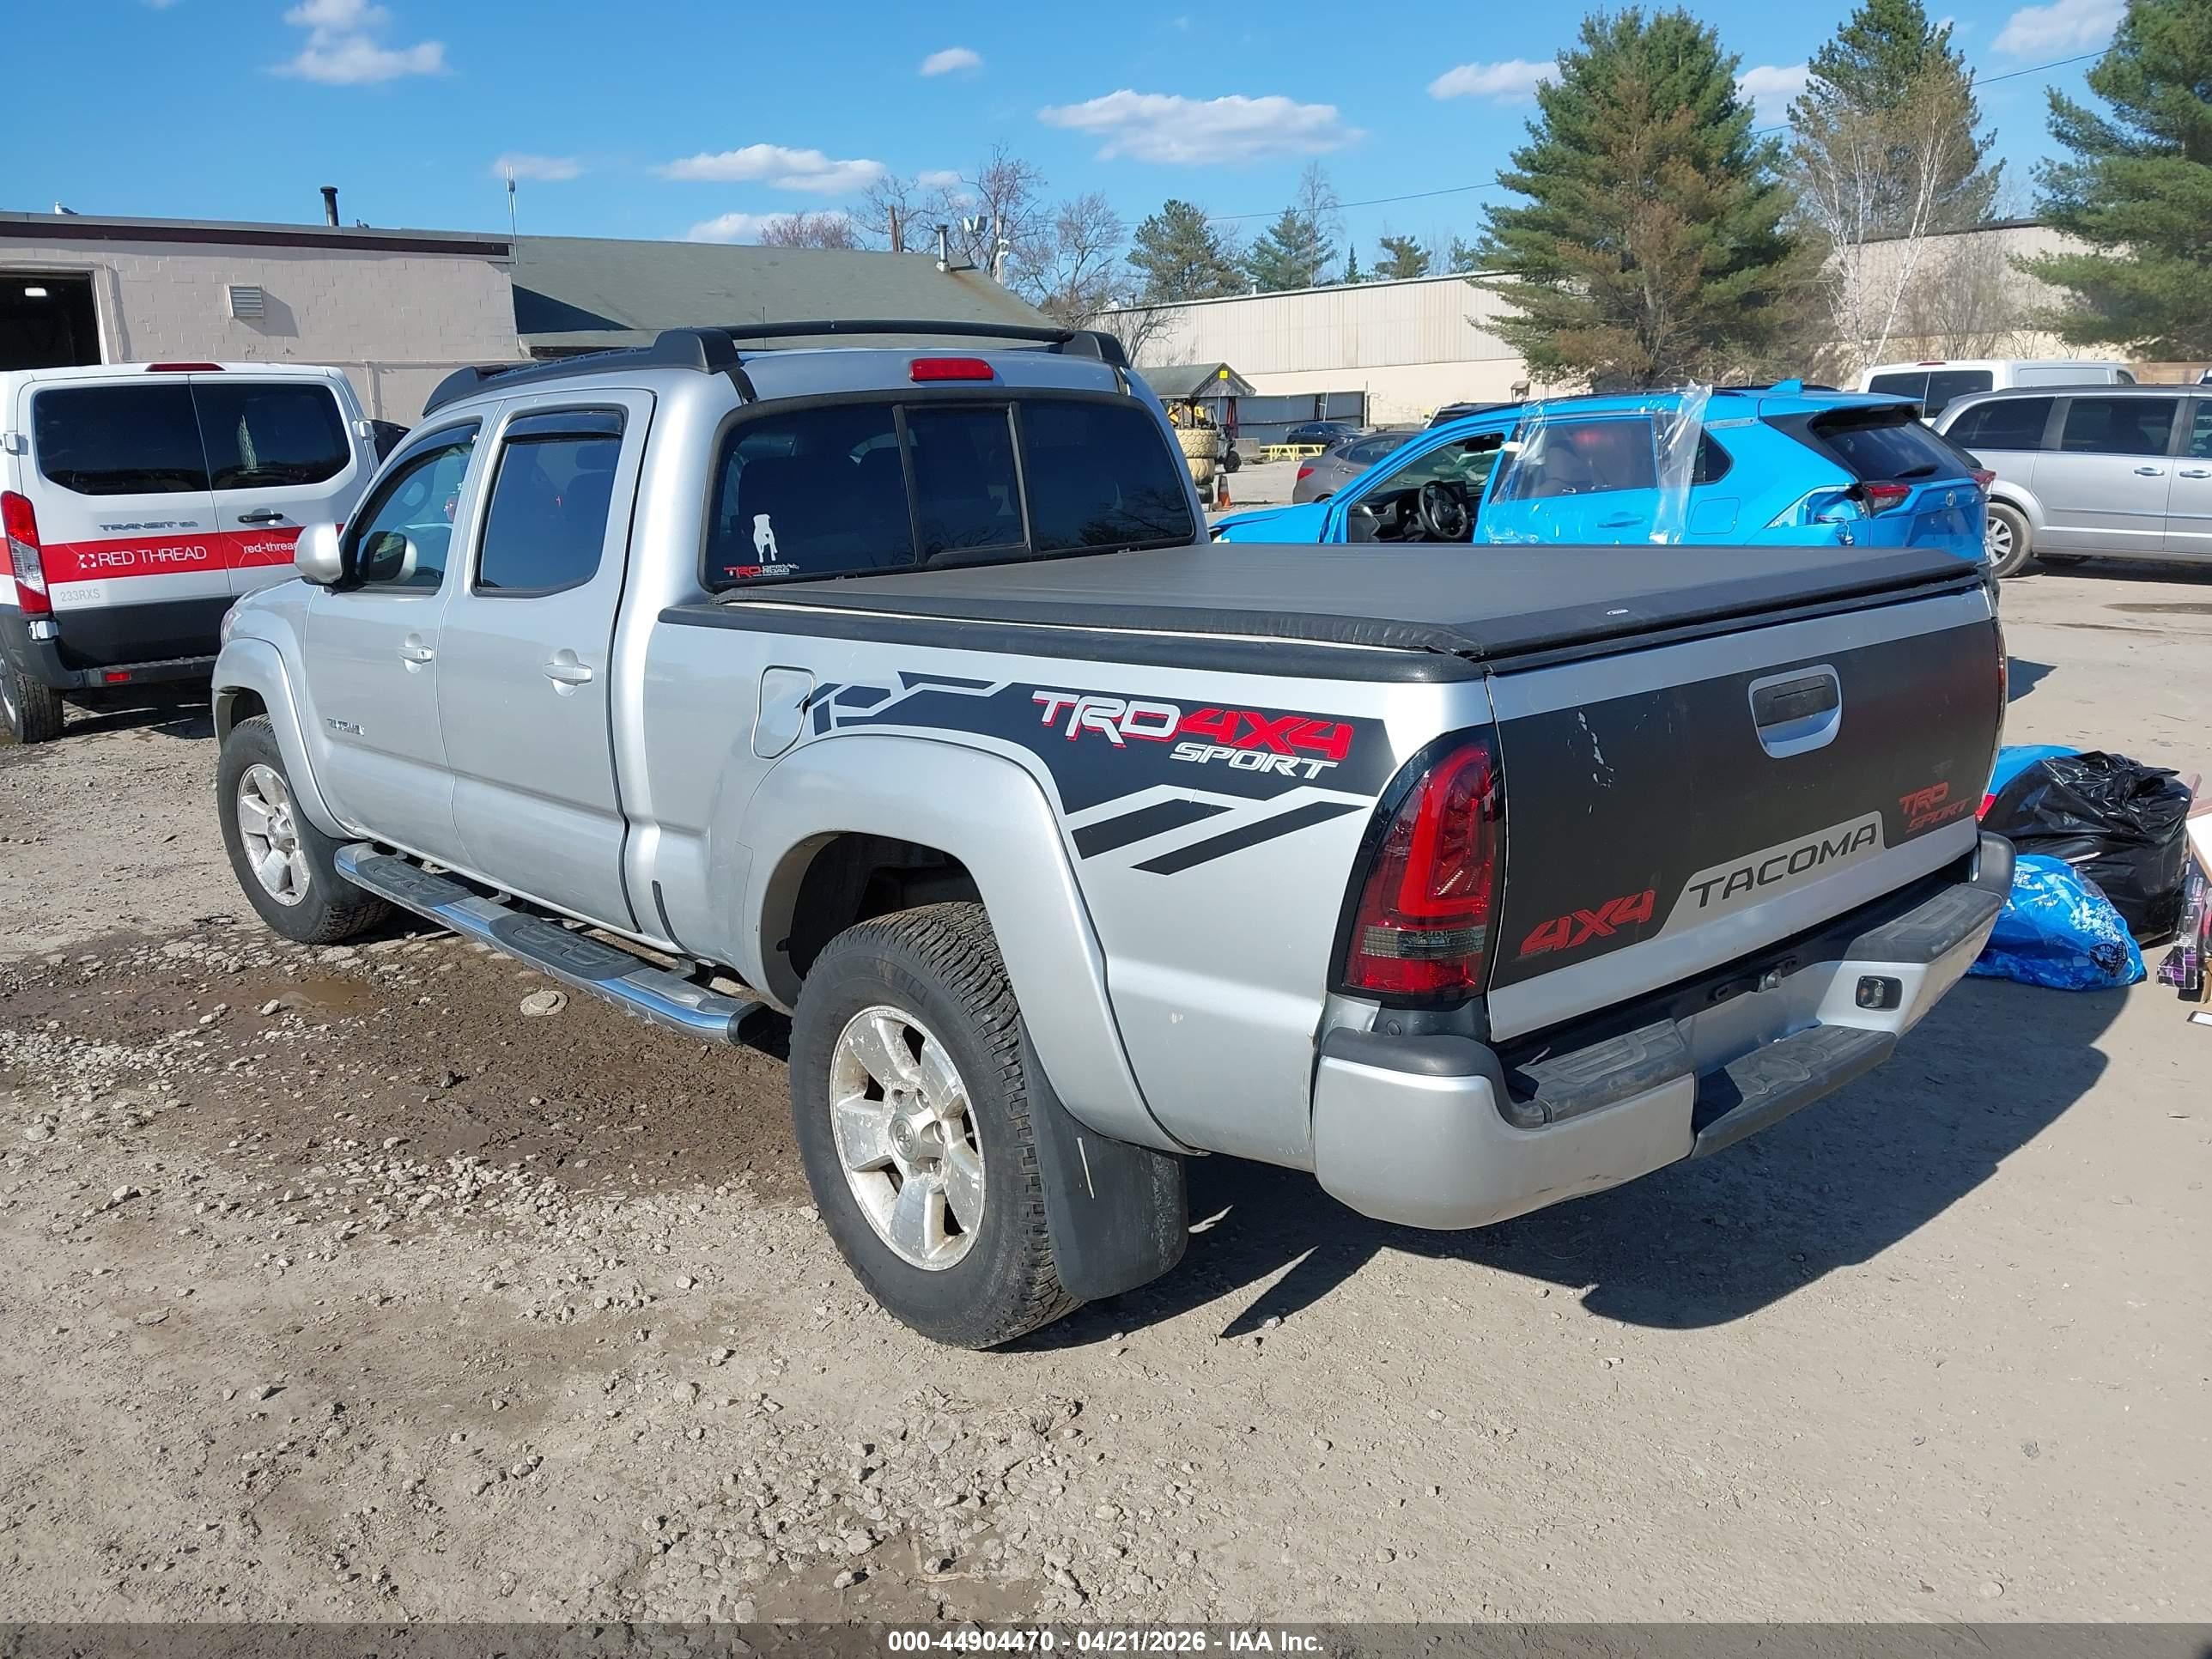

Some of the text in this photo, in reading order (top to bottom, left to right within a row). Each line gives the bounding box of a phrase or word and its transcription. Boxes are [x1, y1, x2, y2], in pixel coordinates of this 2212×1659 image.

[99, 521, 177, 532] TRANSIT
[99, 545, 207, 567] RED THREAD
[723, 565, 761, 578] TRD
[60, 588, 100, 602] 233RXS
[1032, 690, 1353, 760] TRD 4X4
[1170, 741, 1339, 780] SPORT
[1899, 781, 1948, 817] TRD
[1905, 797, 1972, 834] SPORT
[1688, 823, 1877, 908] TACOMA
[1519, 889, 1656, 956] 4X4
